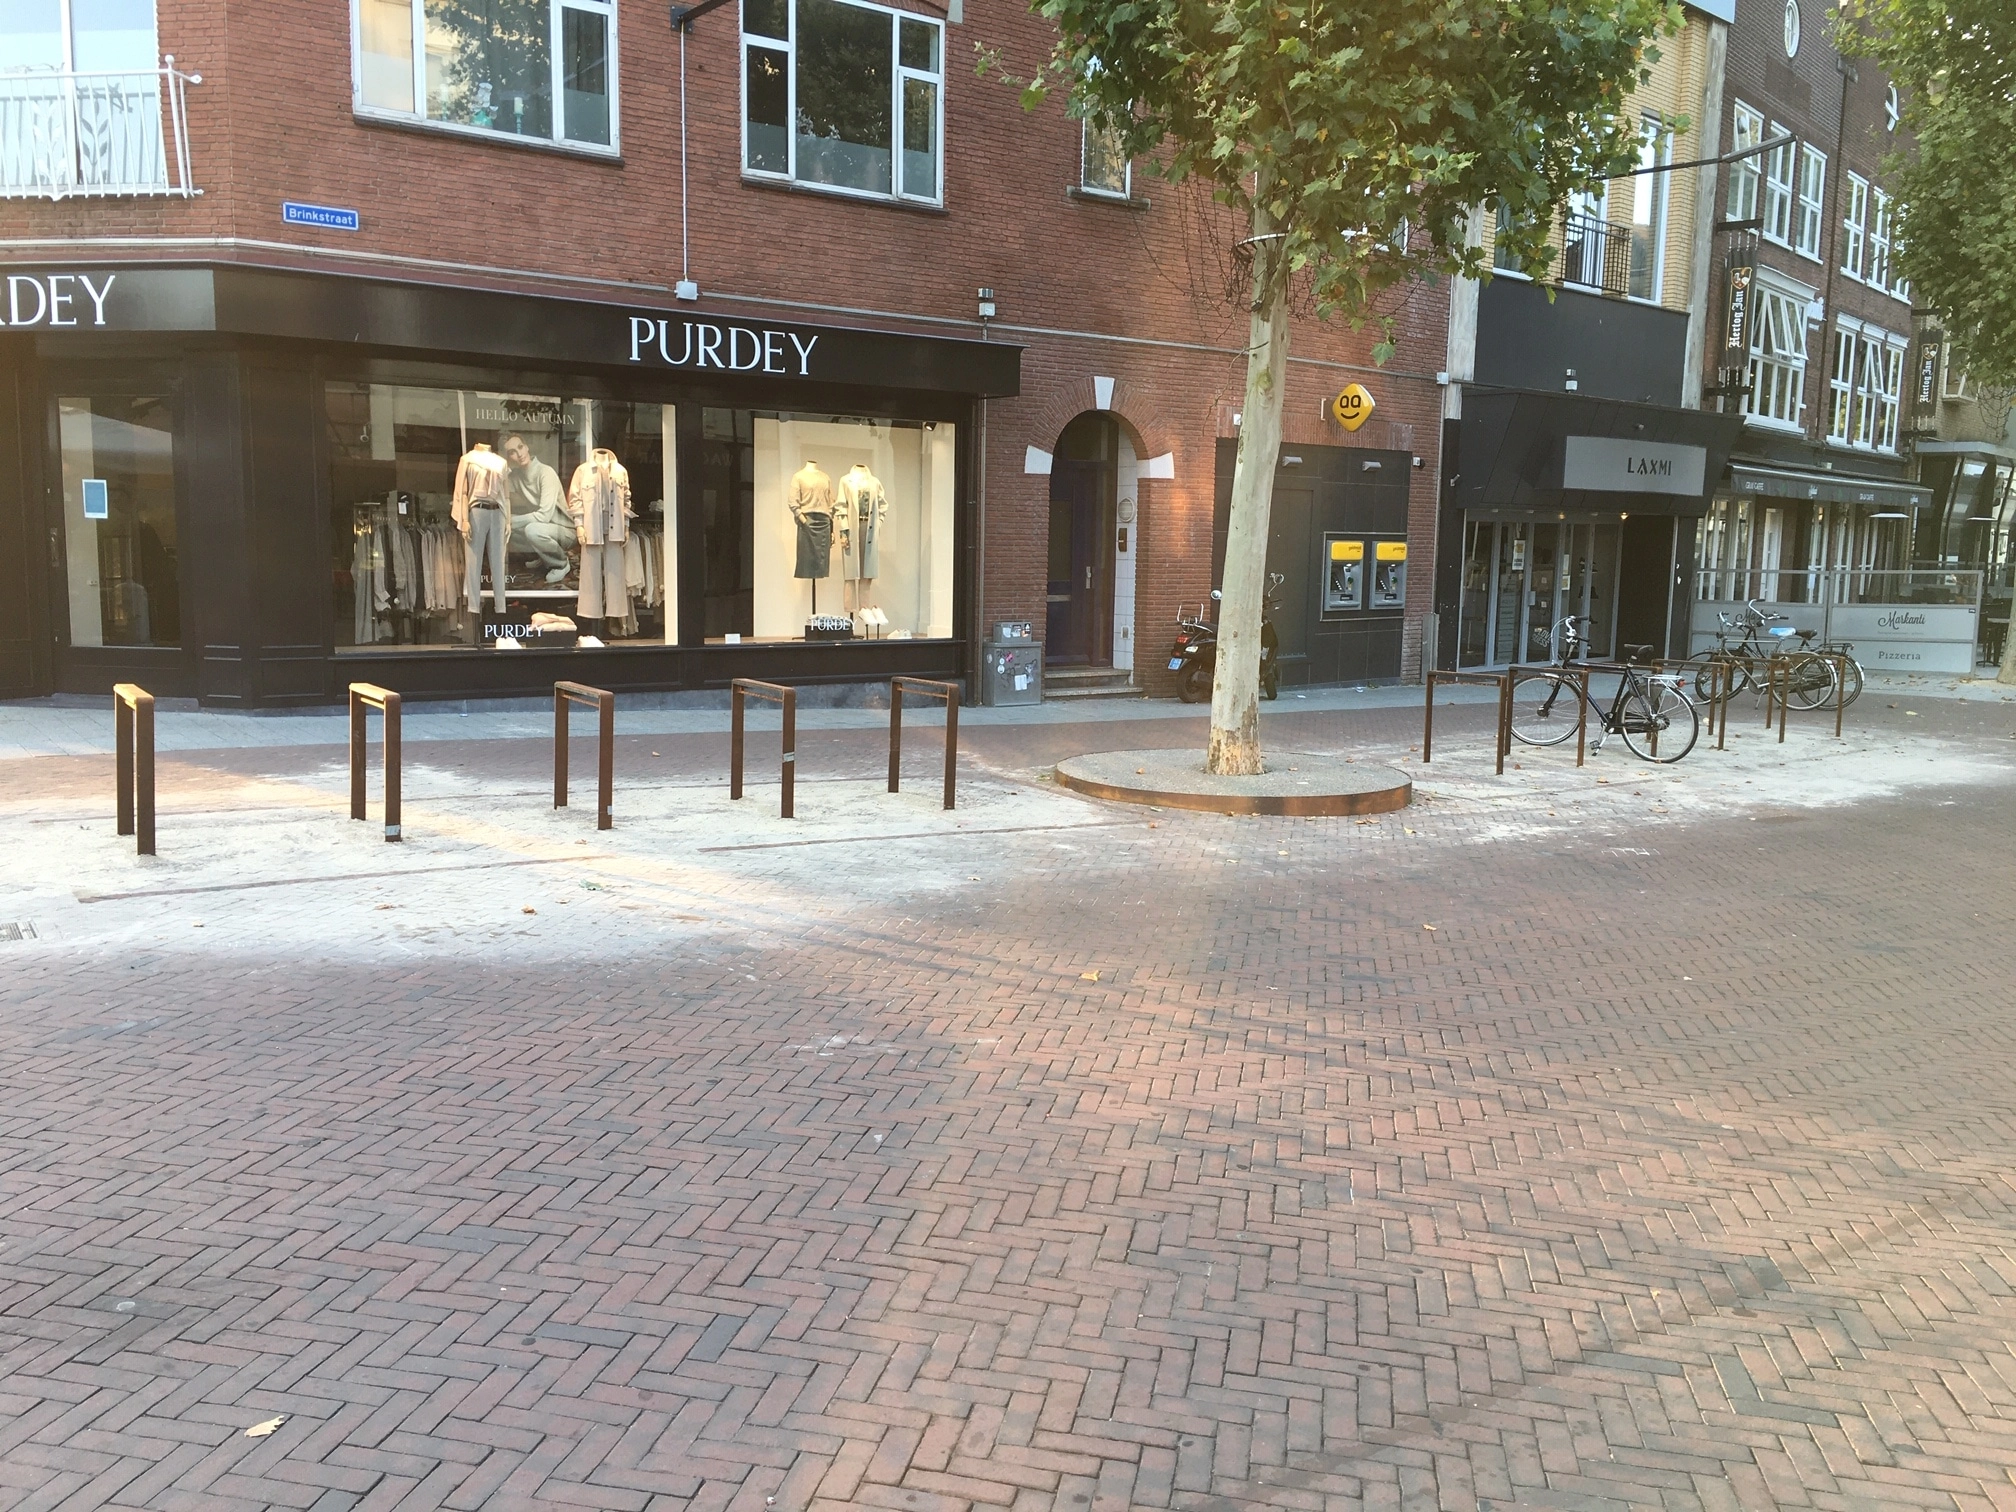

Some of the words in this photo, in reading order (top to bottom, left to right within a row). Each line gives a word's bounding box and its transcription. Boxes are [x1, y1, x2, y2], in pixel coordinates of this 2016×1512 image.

[289, 207, 353, 225] Brinkstraat
[0, 274, 116, 325] DEY
[1728, 312, 1743, 348] Hertog
[628, 316, 819, 375] PURDEY
[476, 408, 518, 422] HELLO
[523, 411, 575, 425] AUTUMN
[1627, 456, 1672, 476] LAXMI
[480, 574, 517, 584] PUEY
[810, 618, 858, 631] PURDEY
[1877, 610, 1926, 630] Markanti
[484, 623, 544, 638] PURDEY
[1878, 650, 1921, 661] Pizzeria
